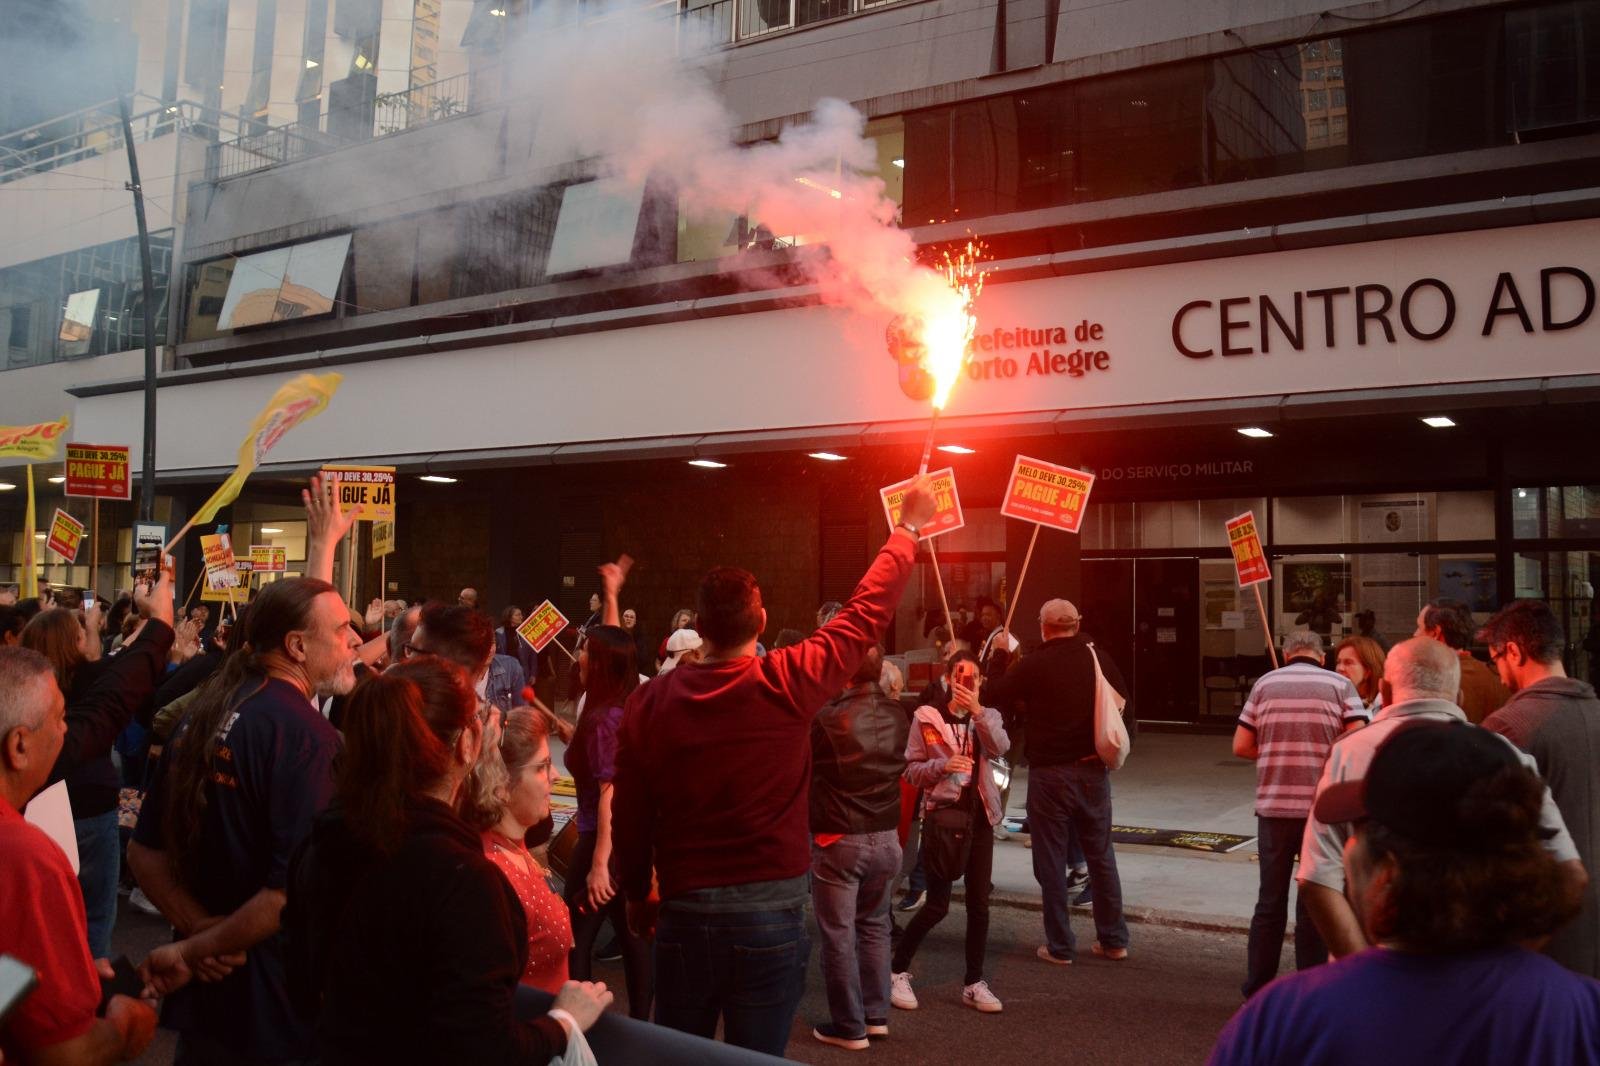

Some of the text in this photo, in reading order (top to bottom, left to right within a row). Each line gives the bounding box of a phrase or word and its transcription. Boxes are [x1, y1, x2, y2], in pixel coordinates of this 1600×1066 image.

[1171, 265, 1597, 360] CENTRO AD
[971, 319, 1104, 352] refeitura de
[966, 348, 1110, 381] orto Alegre
[69, 462, 125, 480] PAGUE JÁ
[344, 472, 361, 482] DEVE
[1018, 465, 1038, 478] MELO
[1039, 471, 1058, 484] DEVE
[1102, 468, 1123, 480] DO
[1127, 463, 1192, 480] SERVIÇO
[1195, 461, 1253, 476] MILITAR
[372, 483, 391, 504] JÁ
[887, 492, 904, 507] MELO
[1013, 480, 1060, 506] PAGUE
[1060, 491, 1082, 512] JÁ
